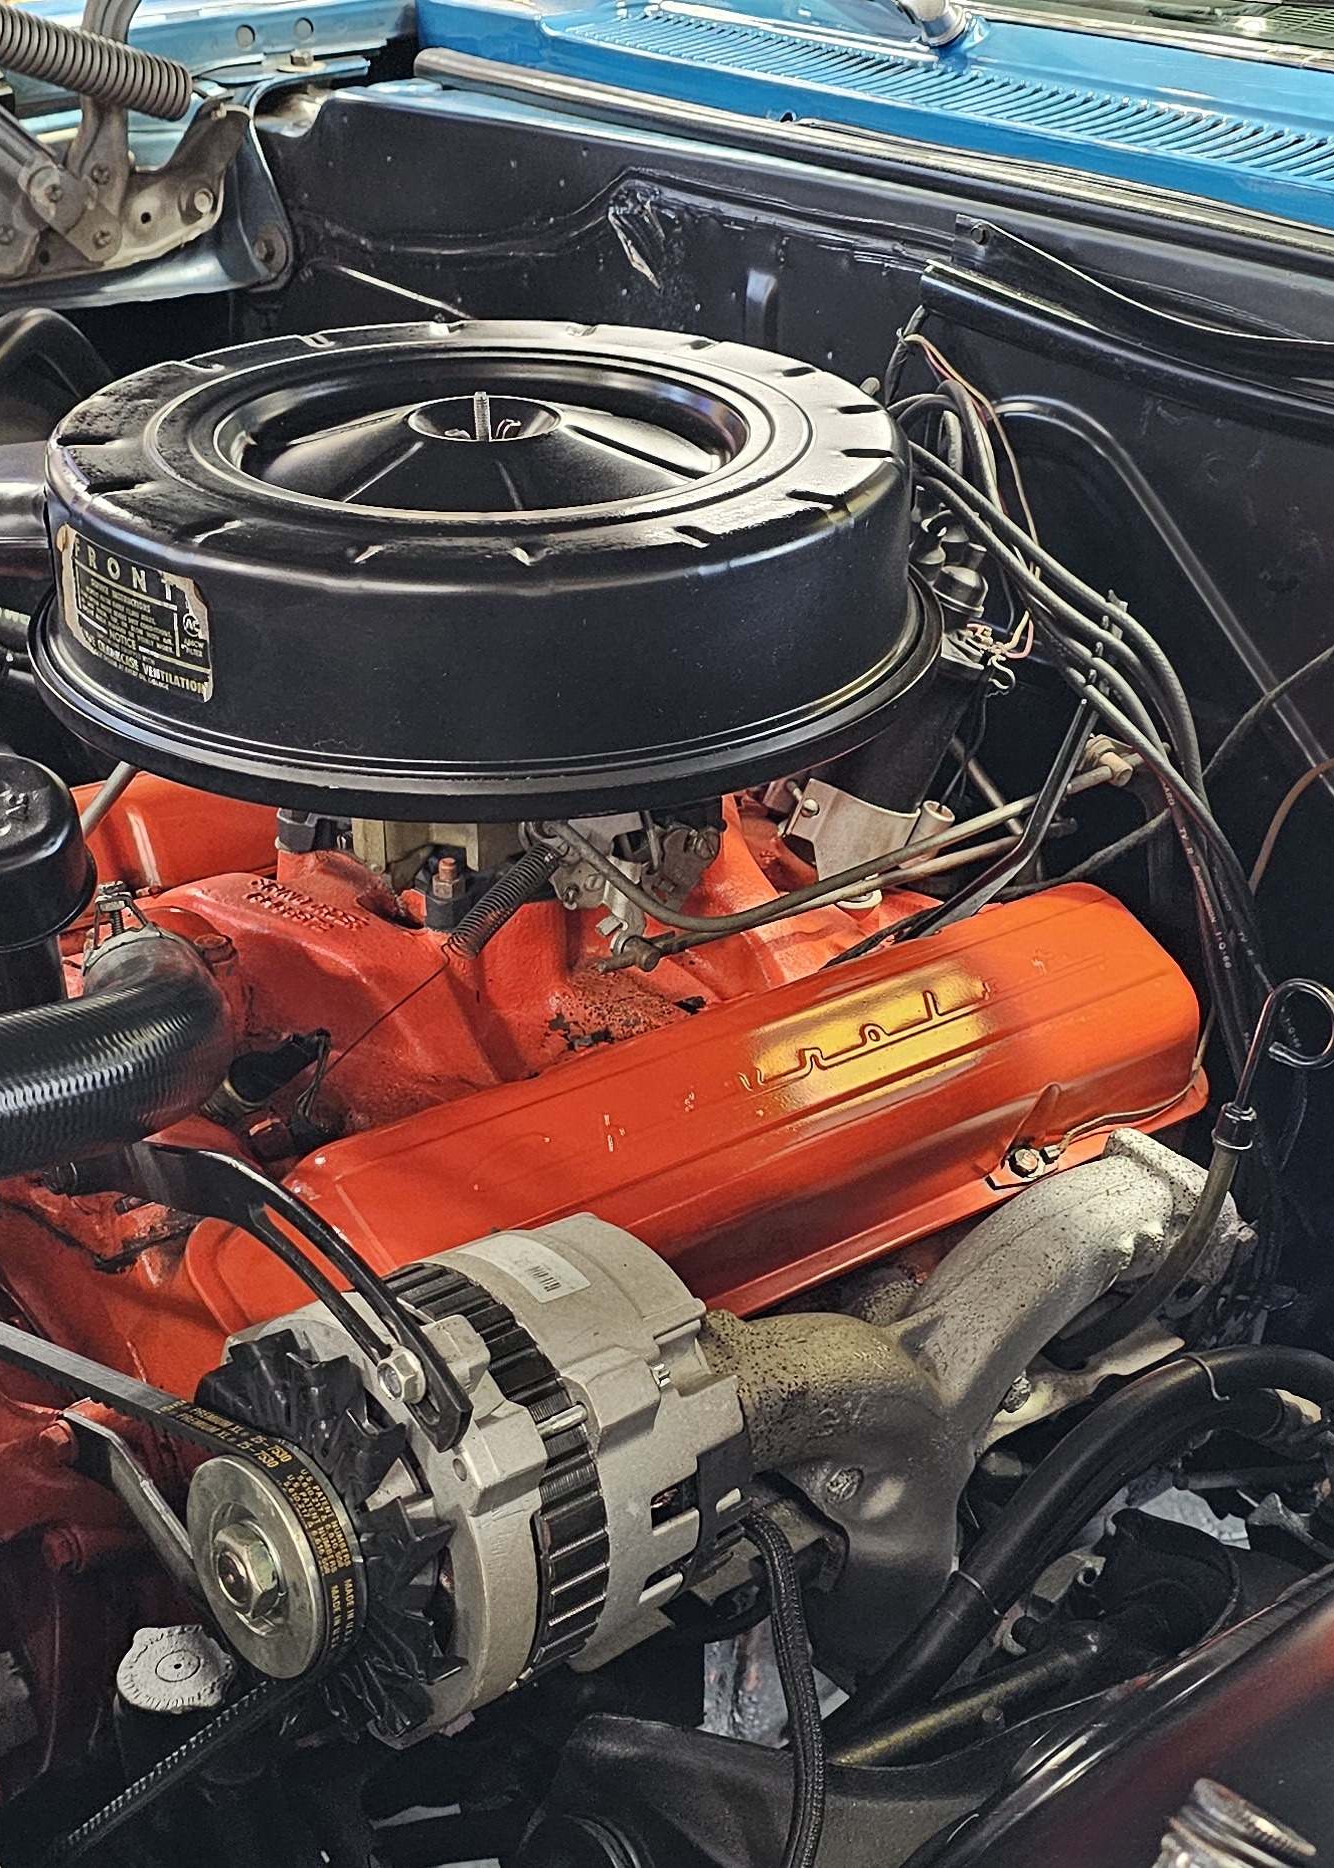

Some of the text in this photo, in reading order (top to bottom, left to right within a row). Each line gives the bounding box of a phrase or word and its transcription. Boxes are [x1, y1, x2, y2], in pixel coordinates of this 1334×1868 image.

[74, 537, 176, 601] FRONT
[108, 629, 137, 650] NOTICE
[142, 662, 208, 694] VENTILATION
[175, 1413, 221, 1434] PREMIUM
[190, 1407, 234, 1429] PREMIUM
[299, 1491, 322, 1525] PATENT
[317, 1526, 338, 1574] NUMBERS
[313, 1485, 334, 1519] PATENT
[332, 1520, 352, 1568] NUMBERS
[331, 1584, 341, 1613] MADE
[343, 1578, 354, 1607] MADE
